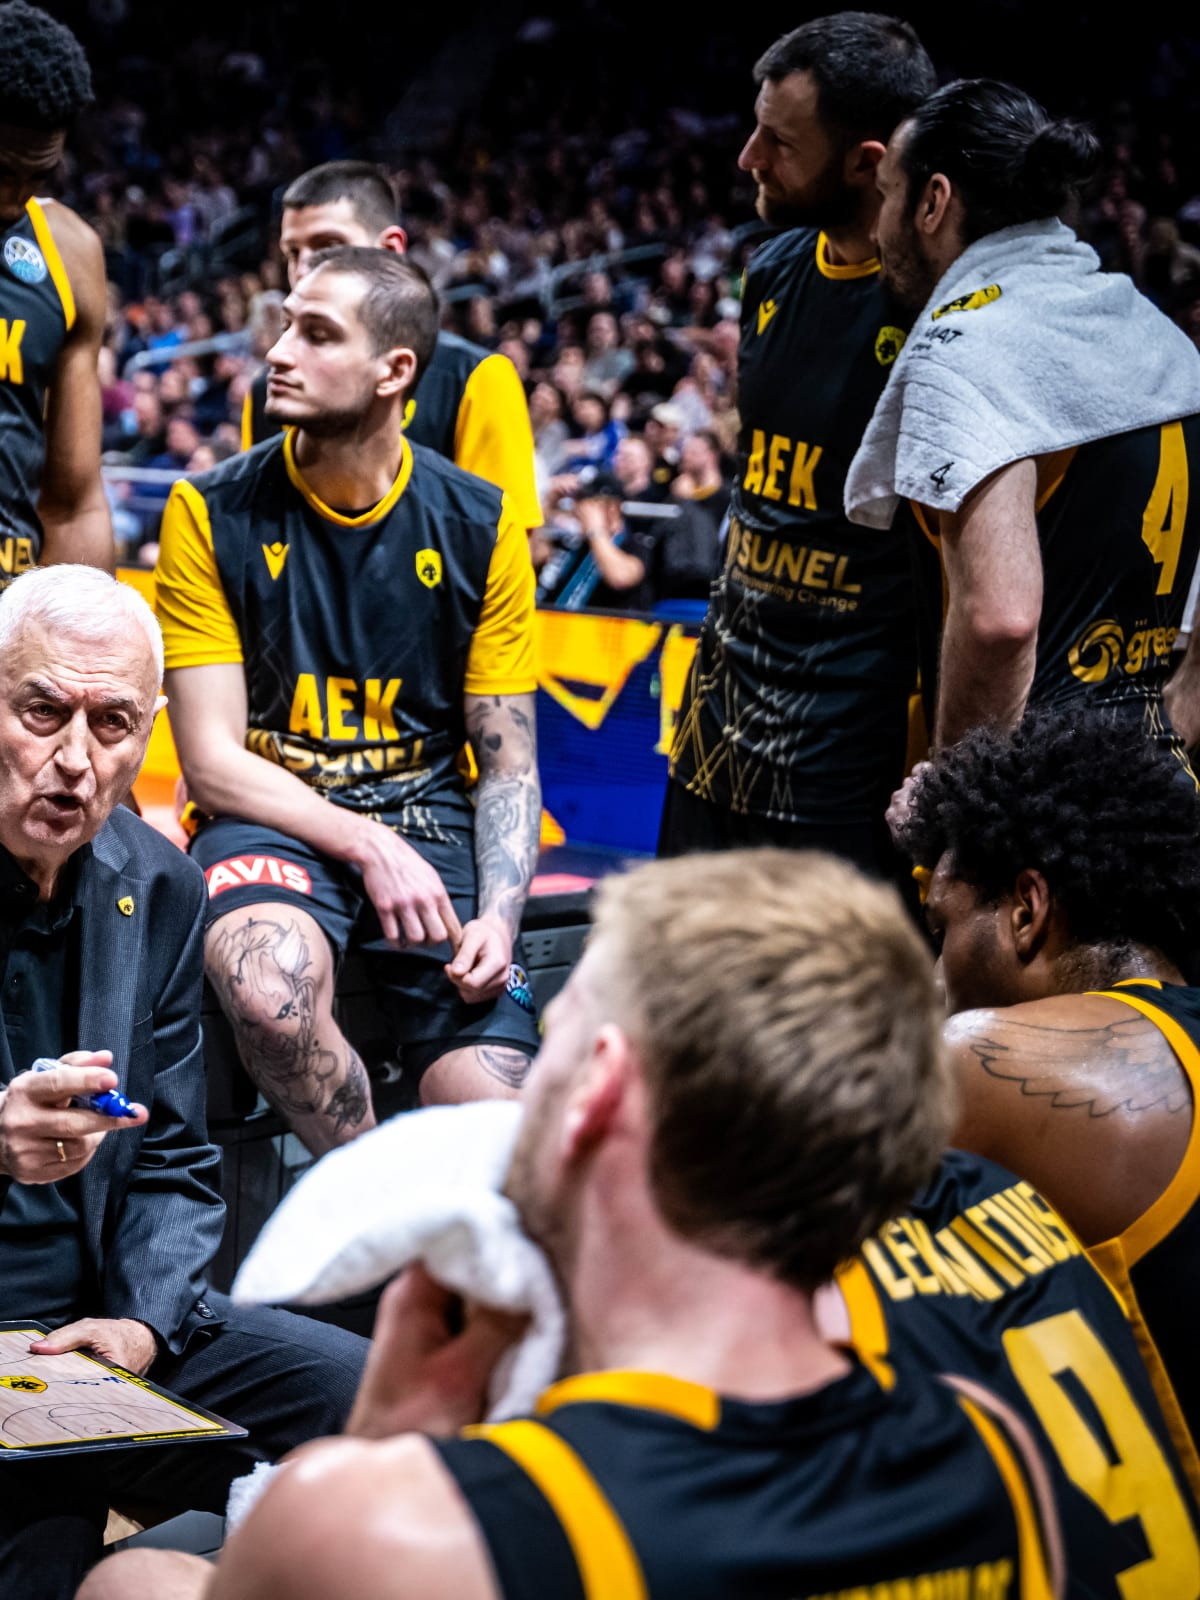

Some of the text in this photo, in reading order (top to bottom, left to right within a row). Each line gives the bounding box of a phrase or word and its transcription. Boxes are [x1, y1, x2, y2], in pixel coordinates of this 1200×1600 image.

[743, 428, 823, 511] AEK
[930, 461, 954, 489] 4
[1141, 421, 1189, 595] 4
[737, 529, 862, 593] SUNEL
[289, 673, 402, 741] AEK
[208, 858, 309, 899] AVIS
[1002, 1309, 1200, 1600] 9
